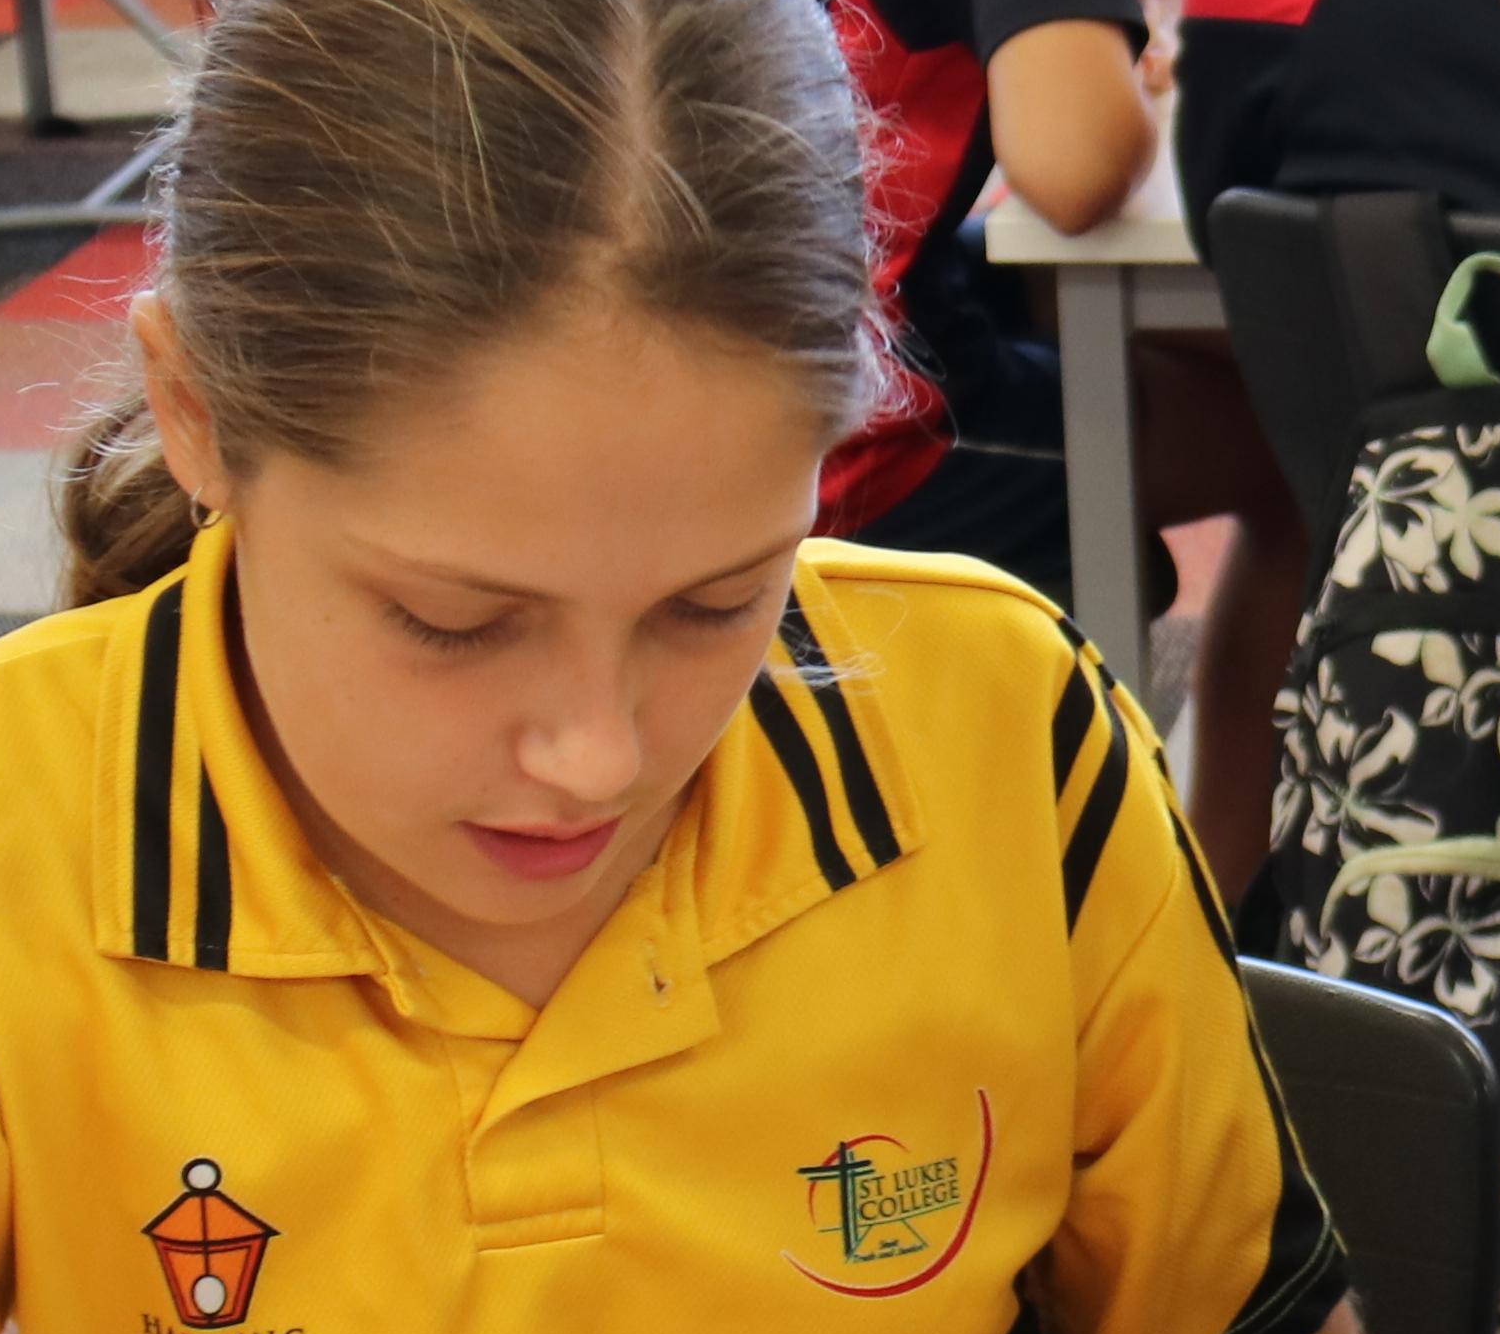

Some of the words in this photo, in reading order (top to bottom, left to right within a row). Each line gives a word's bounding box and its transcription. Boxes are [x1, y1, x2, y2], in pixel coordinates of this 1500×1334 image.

[860, 1176, 885, 1199] ST
[894, 1158, 959, 1192] LUKE'S
[860, 1179, 960, 1221] COLLEGE
